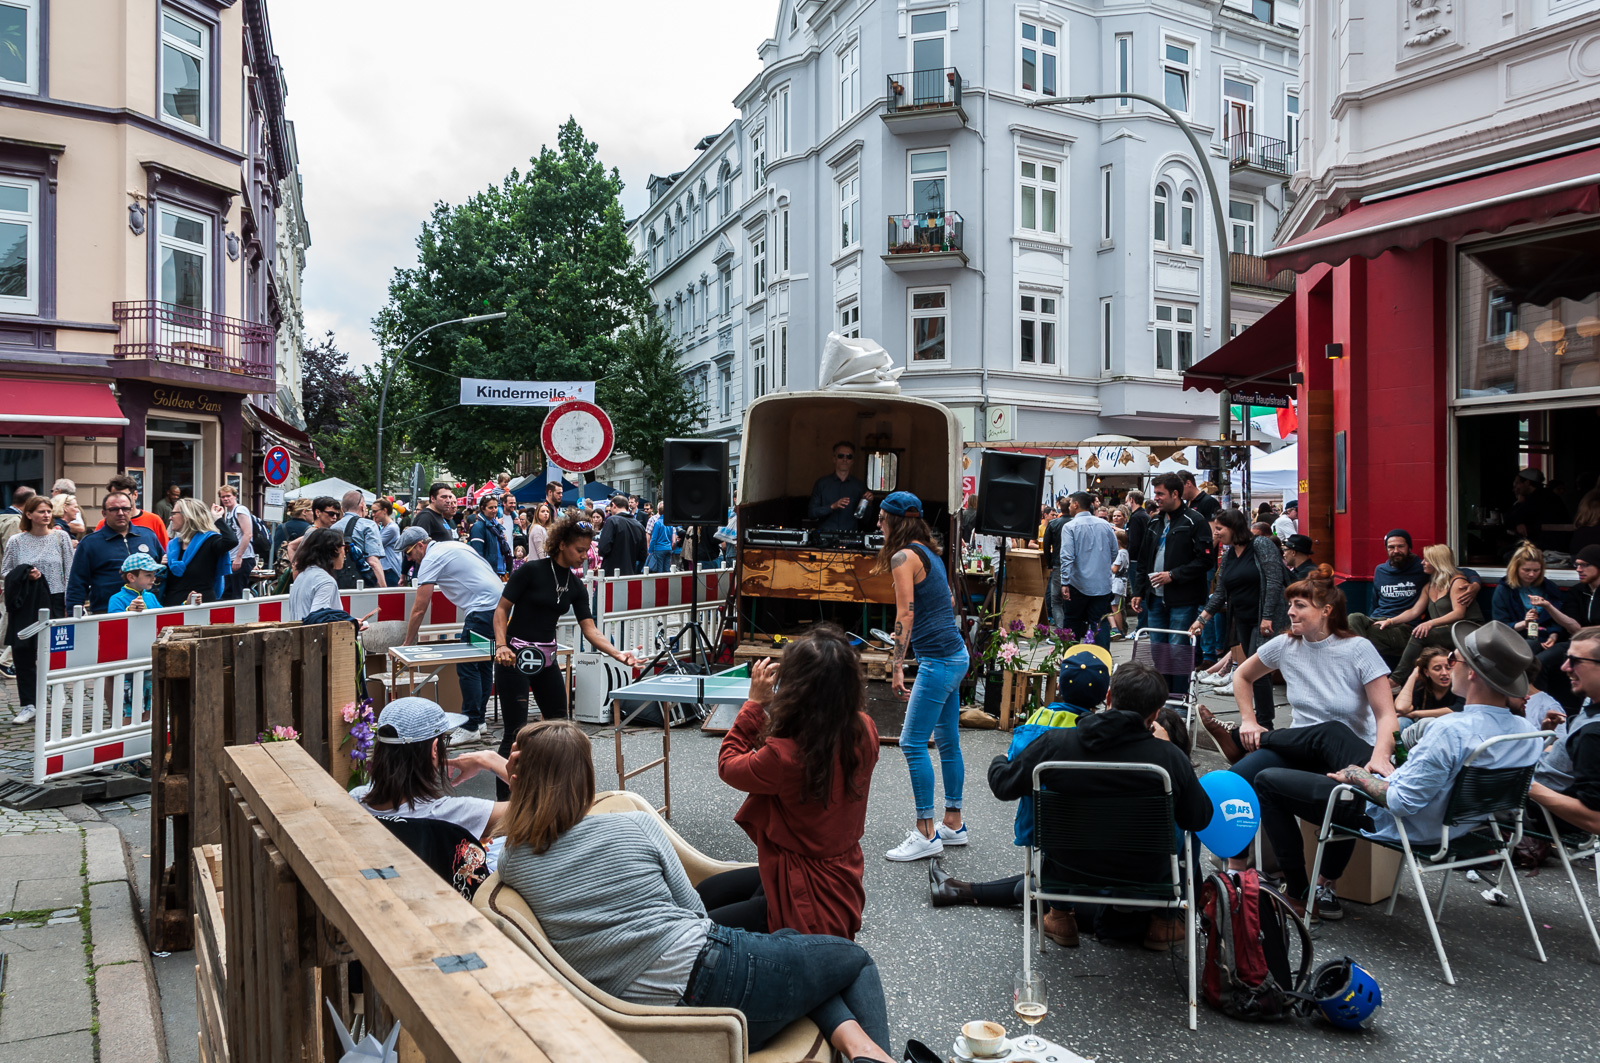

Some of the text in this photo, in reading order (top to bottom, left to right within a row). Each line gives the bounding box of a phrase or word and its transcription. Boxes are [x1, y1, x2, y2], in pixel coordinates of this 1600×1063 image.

[476, 385, 566, 399] Kindermeile
[152, 389, 222, 412] Goldene Gans
[1238, 806, 1250, 814] AFS
